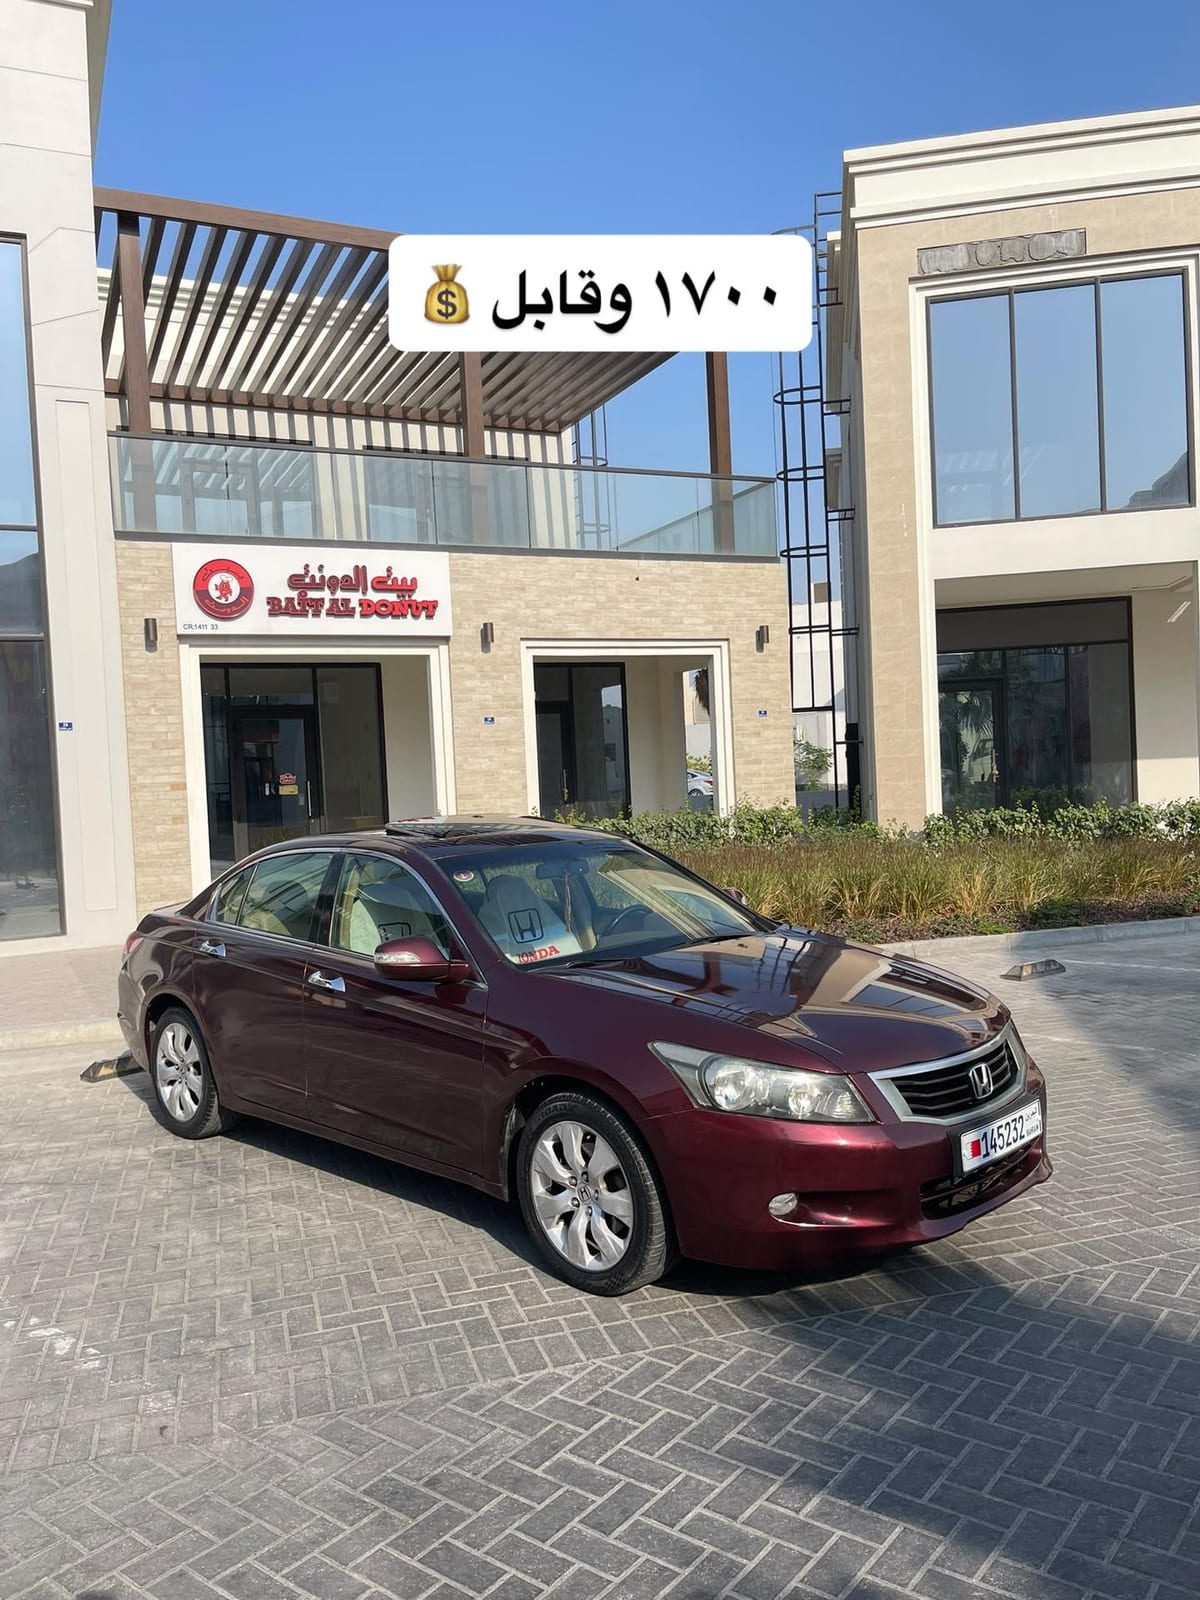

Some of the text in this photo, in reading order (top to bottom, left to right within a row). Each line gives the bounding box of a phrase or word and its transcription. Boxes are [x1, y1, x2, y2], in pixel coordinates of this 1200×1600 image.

[287, 563, 417, 598] بيت الدونت
[266, 590, 438, 619] BAIT AL DONUT
[981, 1115, 1025, 1159] 145232
